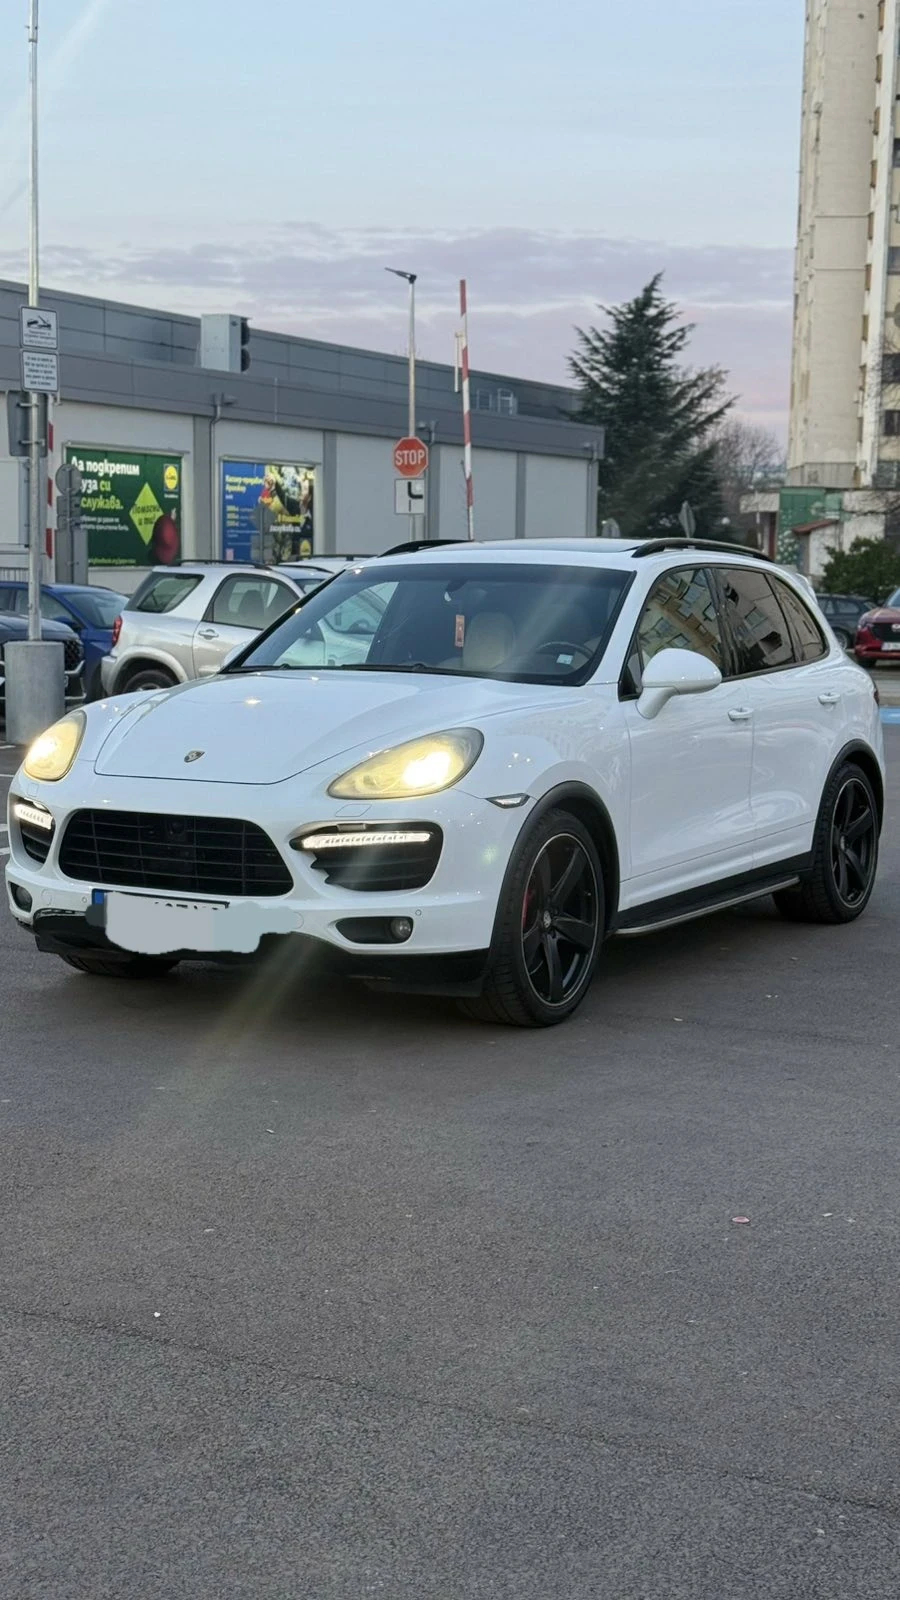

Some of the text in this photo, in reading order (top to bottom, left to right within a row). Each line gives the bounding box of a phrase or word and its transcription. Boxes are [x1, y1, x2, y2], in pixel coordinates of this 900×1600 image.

[395, 450, 426, 466] STOP
[86, 459, 140, 477] подкрепим
[81, 479, 111, 494] уза си
[81, 496, 124, 511] служава.
